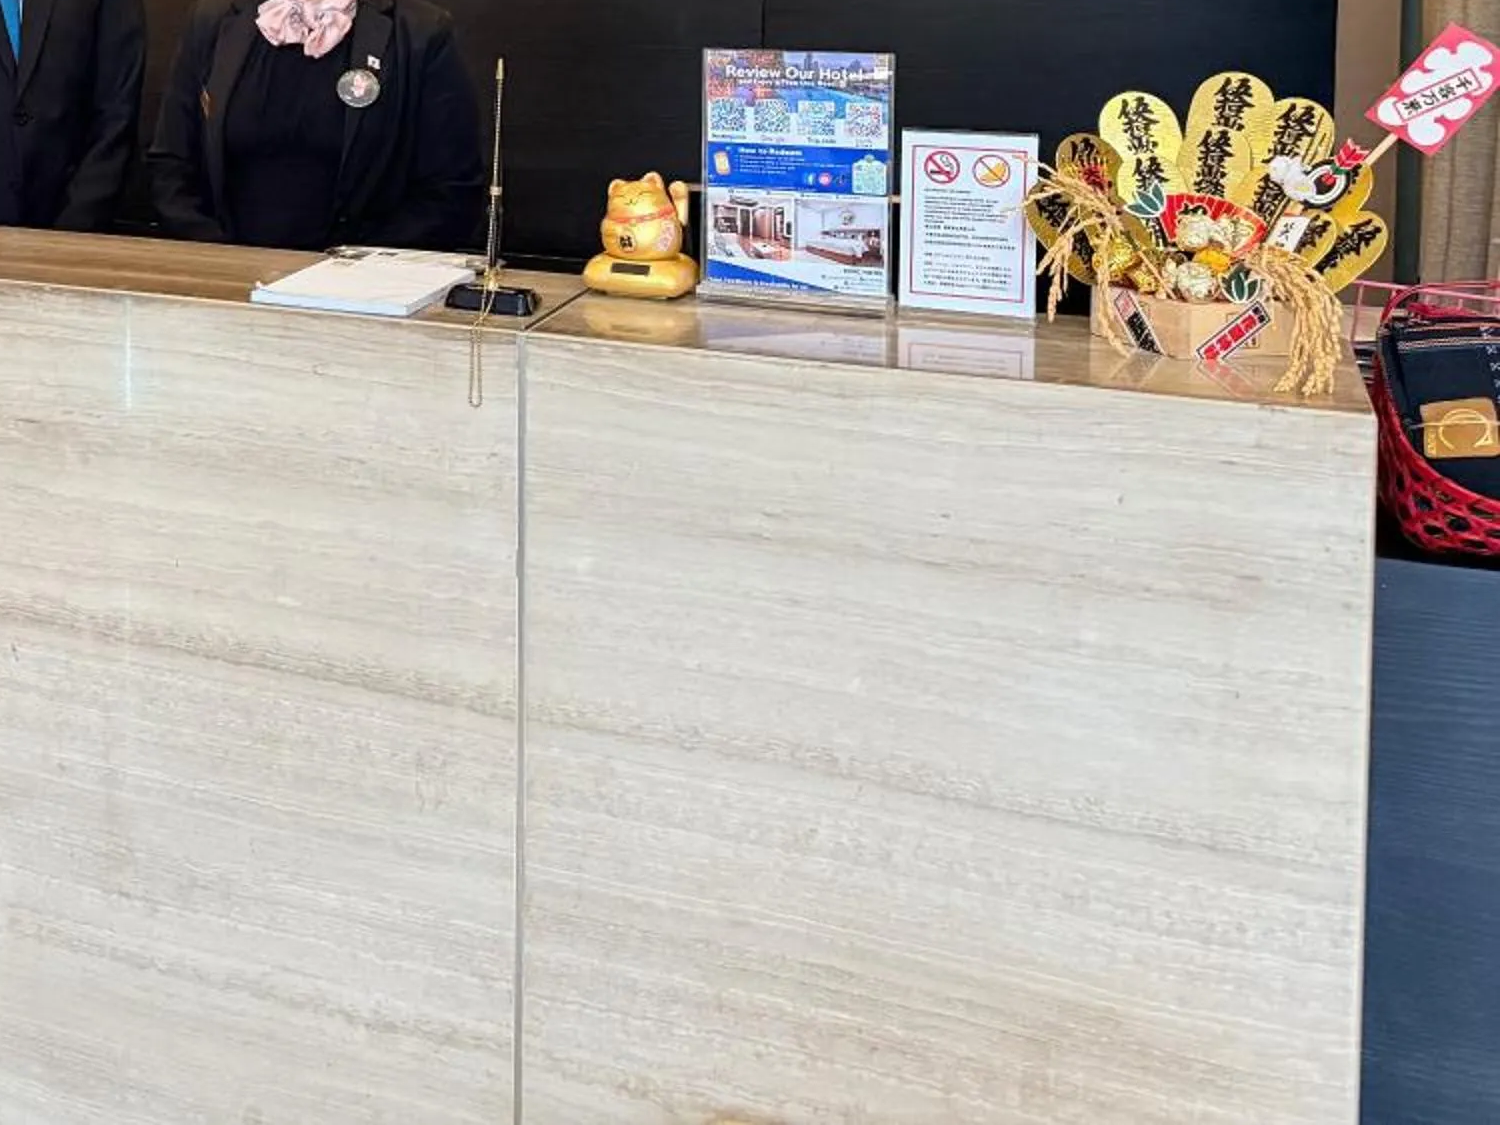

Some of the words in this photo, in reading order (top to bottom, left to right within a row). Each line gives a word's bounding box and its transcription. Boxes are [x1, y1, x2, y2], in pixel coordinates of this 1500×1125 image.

[725, 64, 781, 78] Review
[786, 66, 815, 79] Our
[1402, 76, 1473, 116] 千客万来
